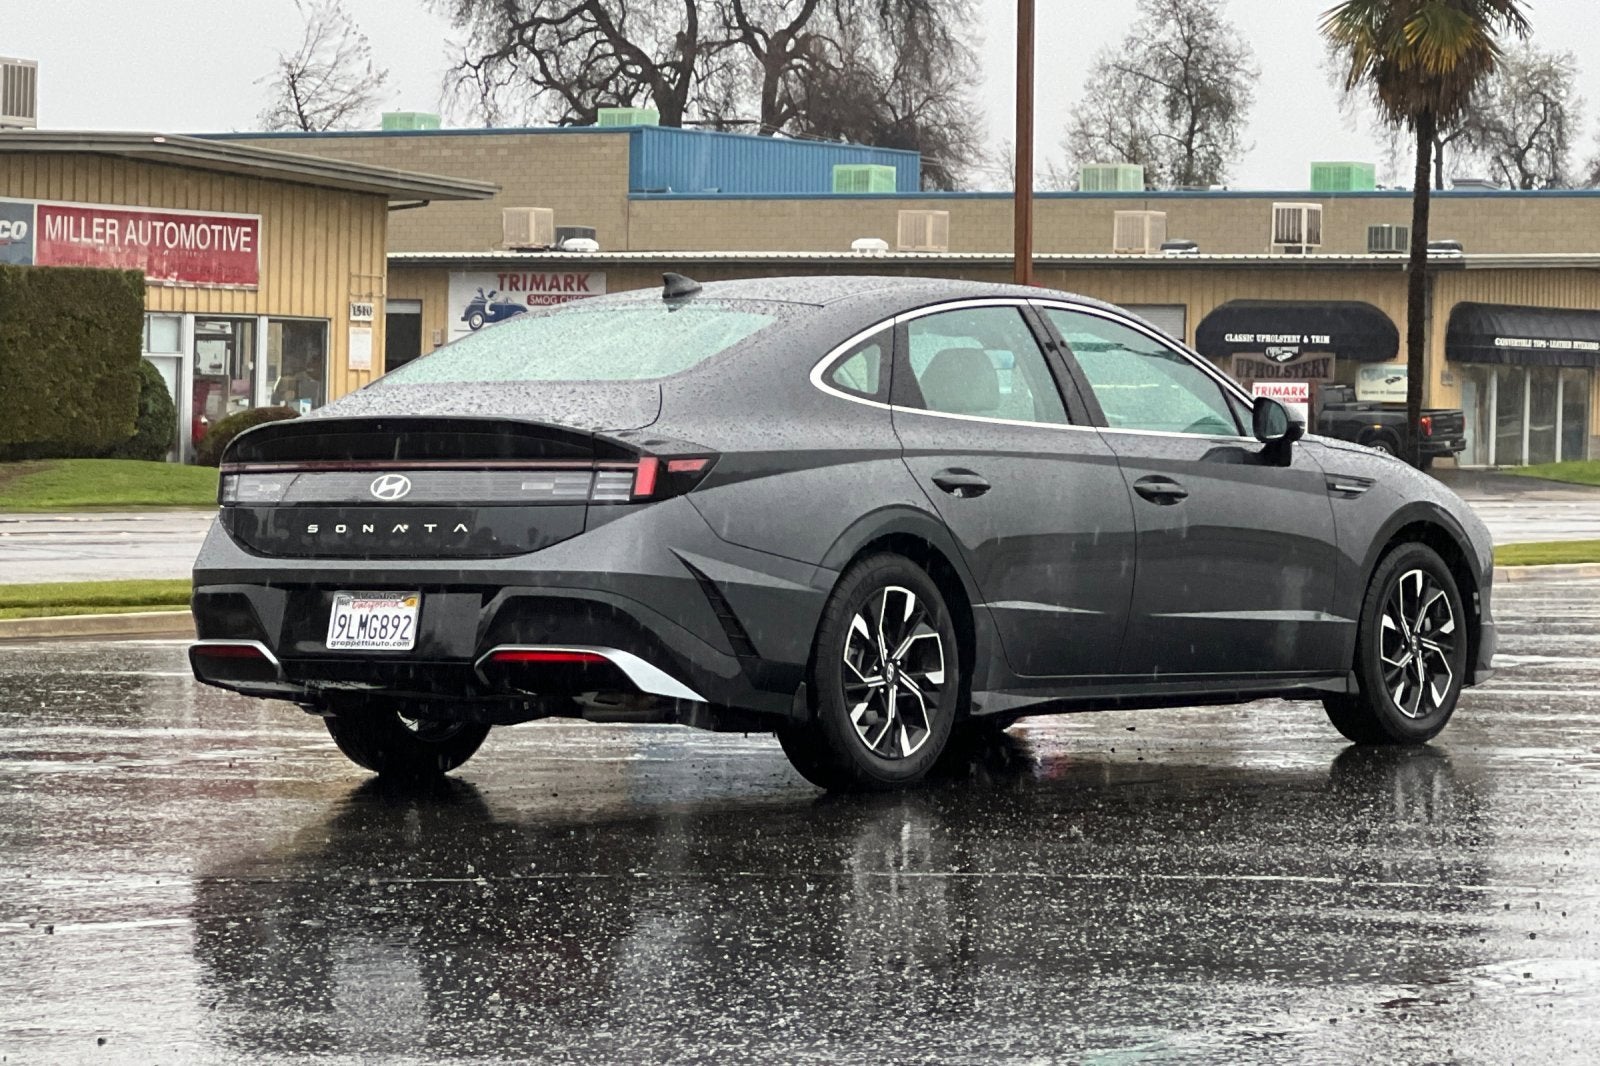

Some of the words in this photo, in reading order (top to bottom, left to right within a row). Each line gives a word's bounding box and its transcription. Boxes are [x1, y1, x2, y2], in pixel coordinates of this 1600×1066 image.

[45, 214, 119, 246] MILLER
[124, 219, 252, 252] AUTOMOTIVE
[497, 273, 590, 292] TRIMARK
[530, 295, 558, 305] SMOG
[1225, 333, 1254, 342] CLASSIC
[1256, 334, 1301, 343] UPHOLSTERY
[1303, 335, 1309, 344] &
[1311, 335, 1330, 344] TRIM
[1236, 358, 1330, 378] UPHOLSTERY
[1255, 386, 1306, 396] TRIMARK
[307, 523, 468, 534] SONATA
[336, 614, 412, 640] 9LMG892
